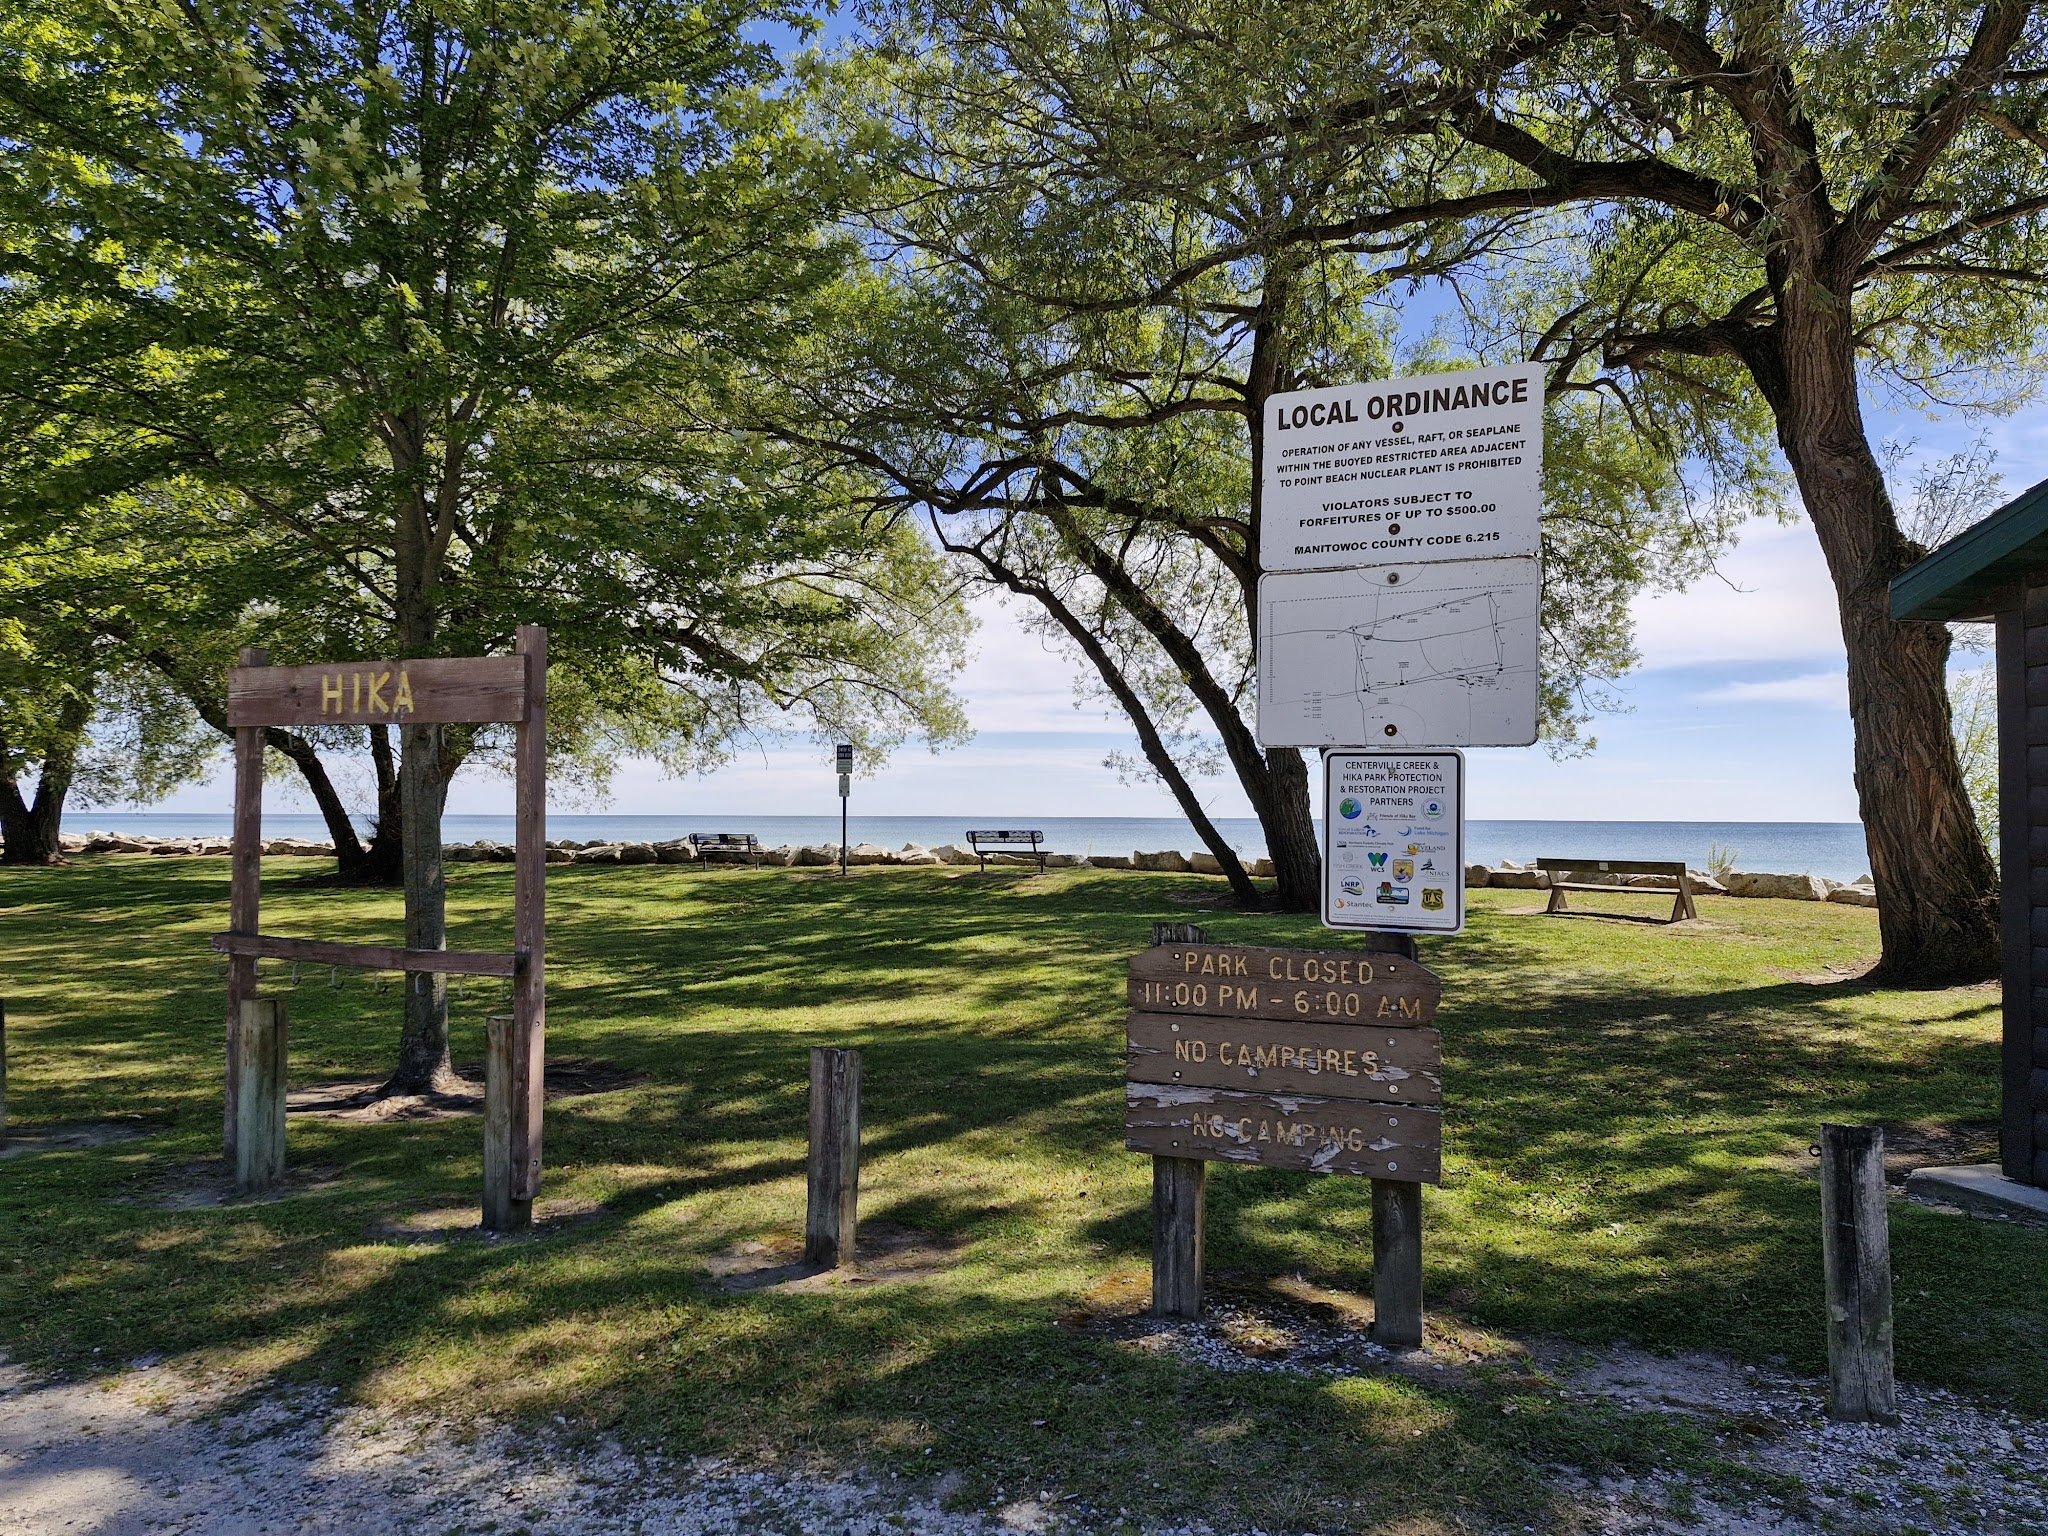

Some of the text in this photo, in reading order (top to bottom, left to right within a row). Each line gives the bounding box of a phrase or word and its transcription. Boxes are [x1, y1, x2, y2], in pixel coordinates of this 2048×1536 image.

[1279, 378, 1528, 430] LOCAL ORDINANCE
[1277, 440, 1526, 473] WITHIN THE BUOYED RESTRICTED AREA ADJACENT
[1282, 424, 1521, 458] OPERATION OF ANY VESSEL, RAFT, OR SEAPLANE
[1280, 457, 1521, 487] TO POINT BEACH NUCLEAR PLANT IS PROHIBITED
[1299, 503, 1496, 527] FORFEITURES OF UP TO $500.00
[1323, 490, 1472, 512] VIOLATORS SUBJECT TO
[1295, 532, 1500, 554] MANITOWOC COUNTY CODE 6.215
[322, 671, 414, 714] HIKA
[1346, 762, 1401, 770] CENTERVILLE
[1403, 762, 1431, 770] CREEK
[1370, 798, 1414, 806] PARTNERS
[1184, 952, 1374, 984] PARK CLOSED
[1145, 982, 1207, 1007] 11:00
[1219, 985, 1257, 1010] PM
[1294, 991, 1360, 1016] 6:00
[1377, 996, 1421, 1019] AM
[1176, 1040, 1379, 1075] NO CAMPFIRES
[1193, 1112, 1363, 1151] NO CAMPING
